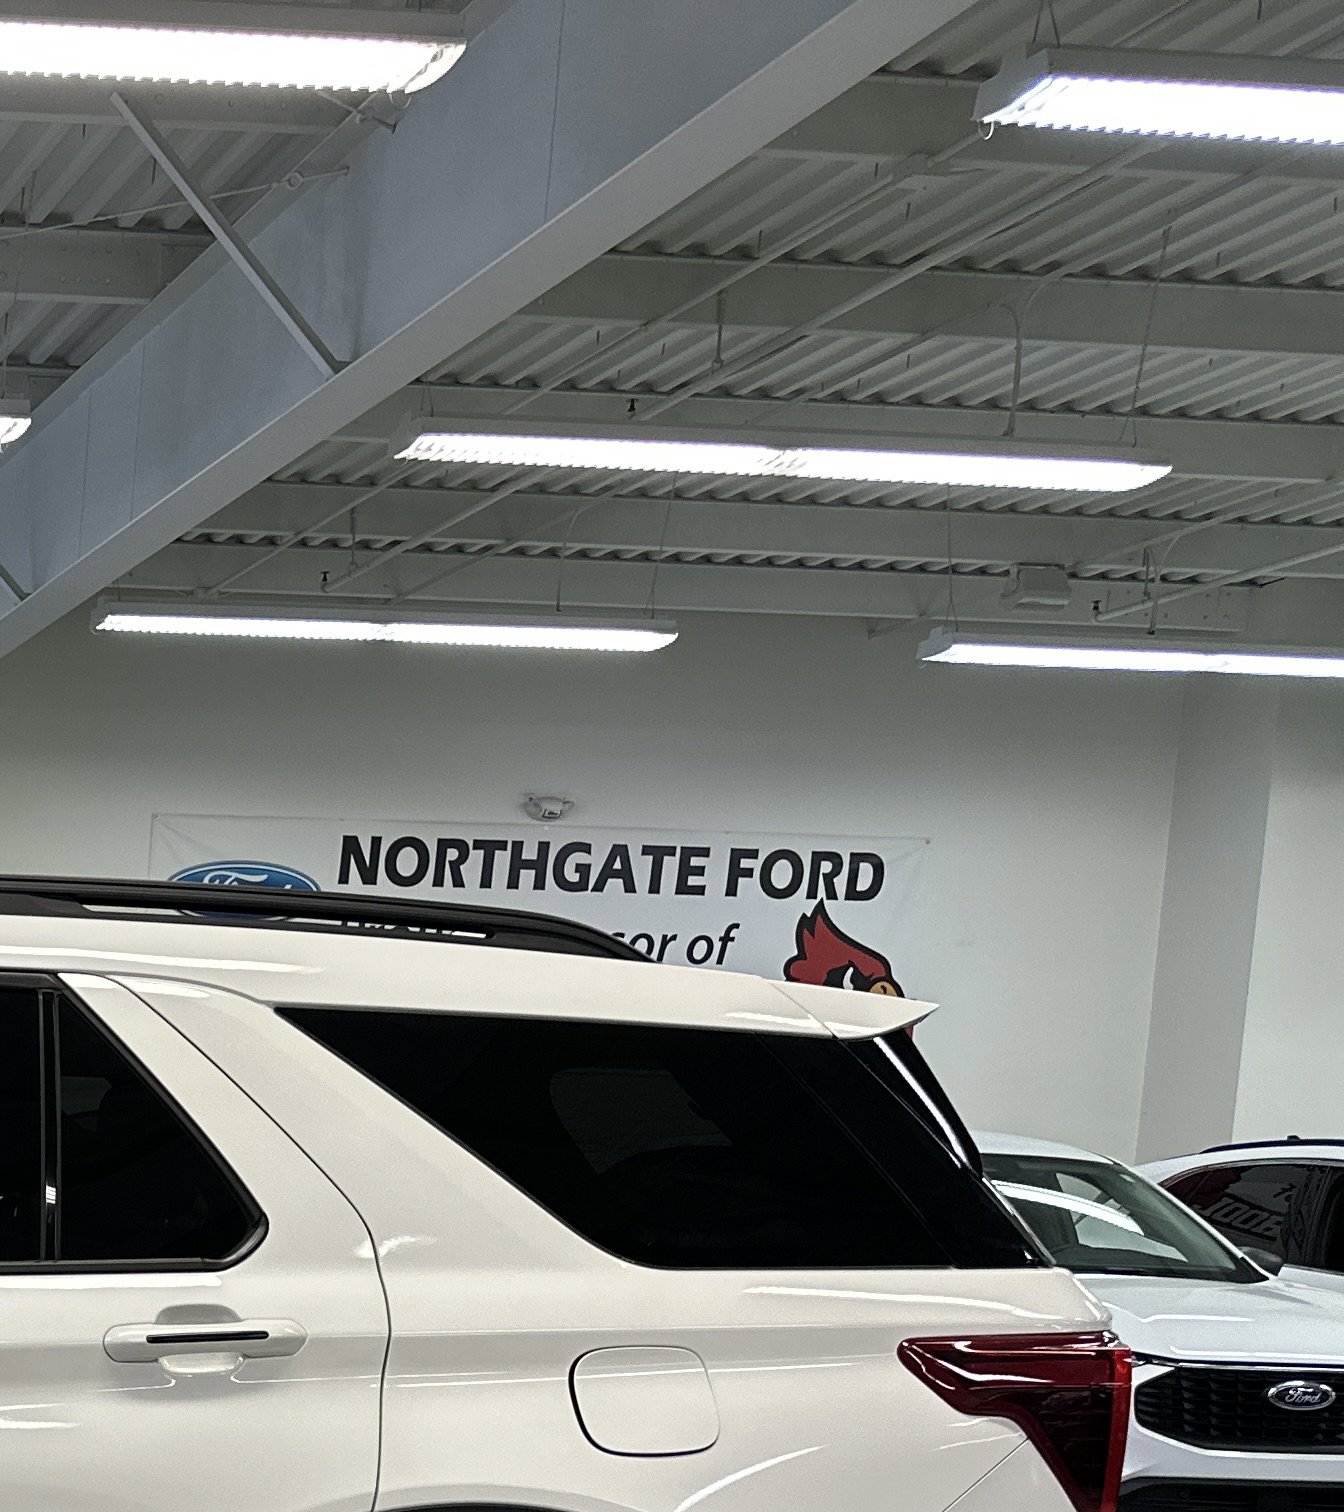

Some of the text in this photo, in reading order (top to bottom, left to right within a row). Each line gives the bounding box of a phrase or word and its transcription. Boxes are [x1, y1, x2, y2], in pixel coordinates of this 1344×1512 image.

[337, 834, 886, 902] NORTHGATE FORD
[686, 922, 741, 966] of
[1284, 1387, 1322, 1405] Ford
